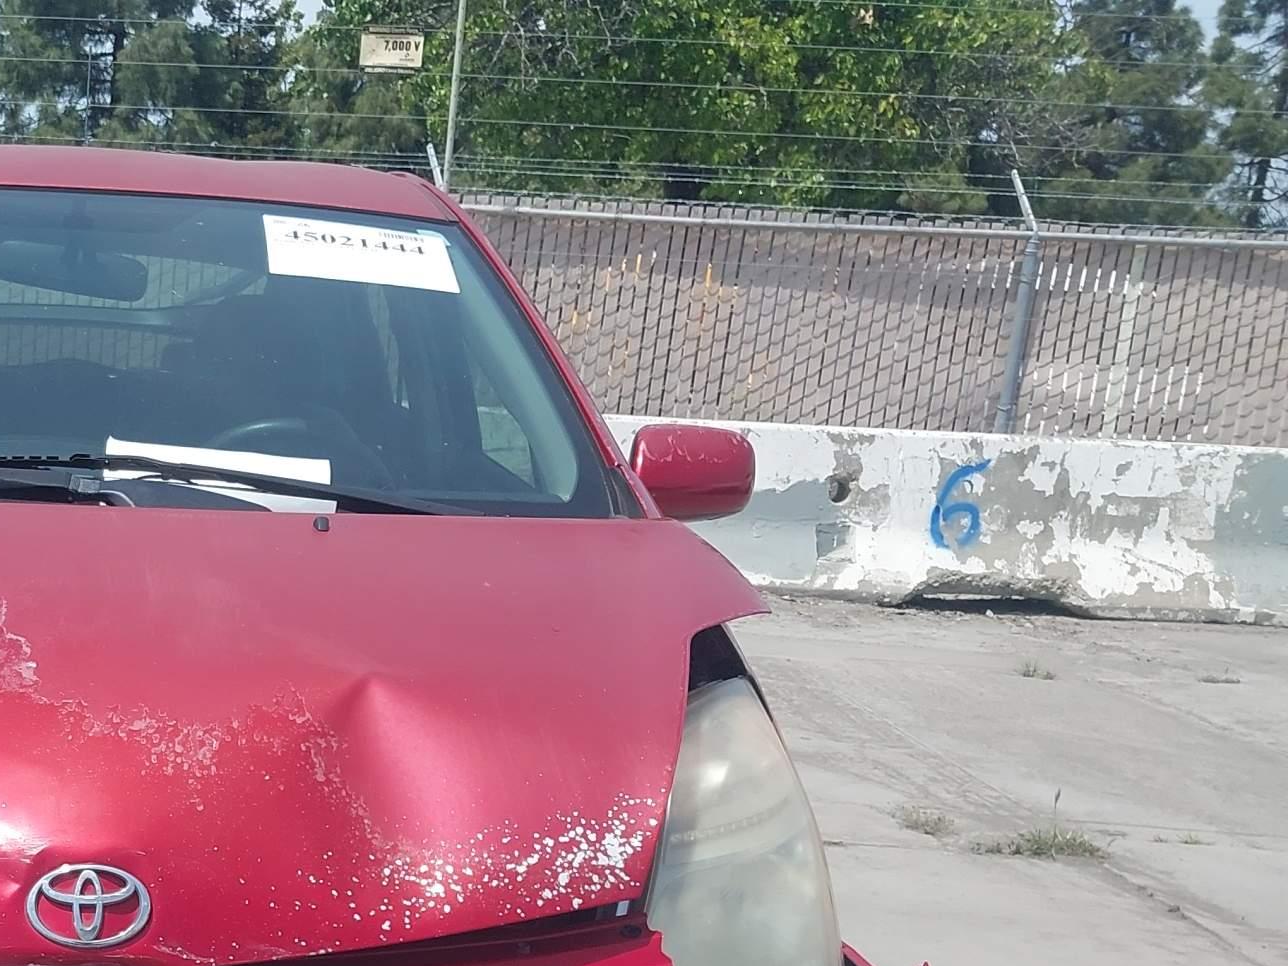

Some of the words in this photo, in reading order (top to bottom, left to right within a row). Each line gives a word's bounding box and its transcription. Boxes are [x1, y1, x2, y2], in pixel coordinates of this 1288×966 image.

[414, 40, 421, 52] V
[284, 230, 425, 255] 45021444
[930, 458, 992, 549] 6
